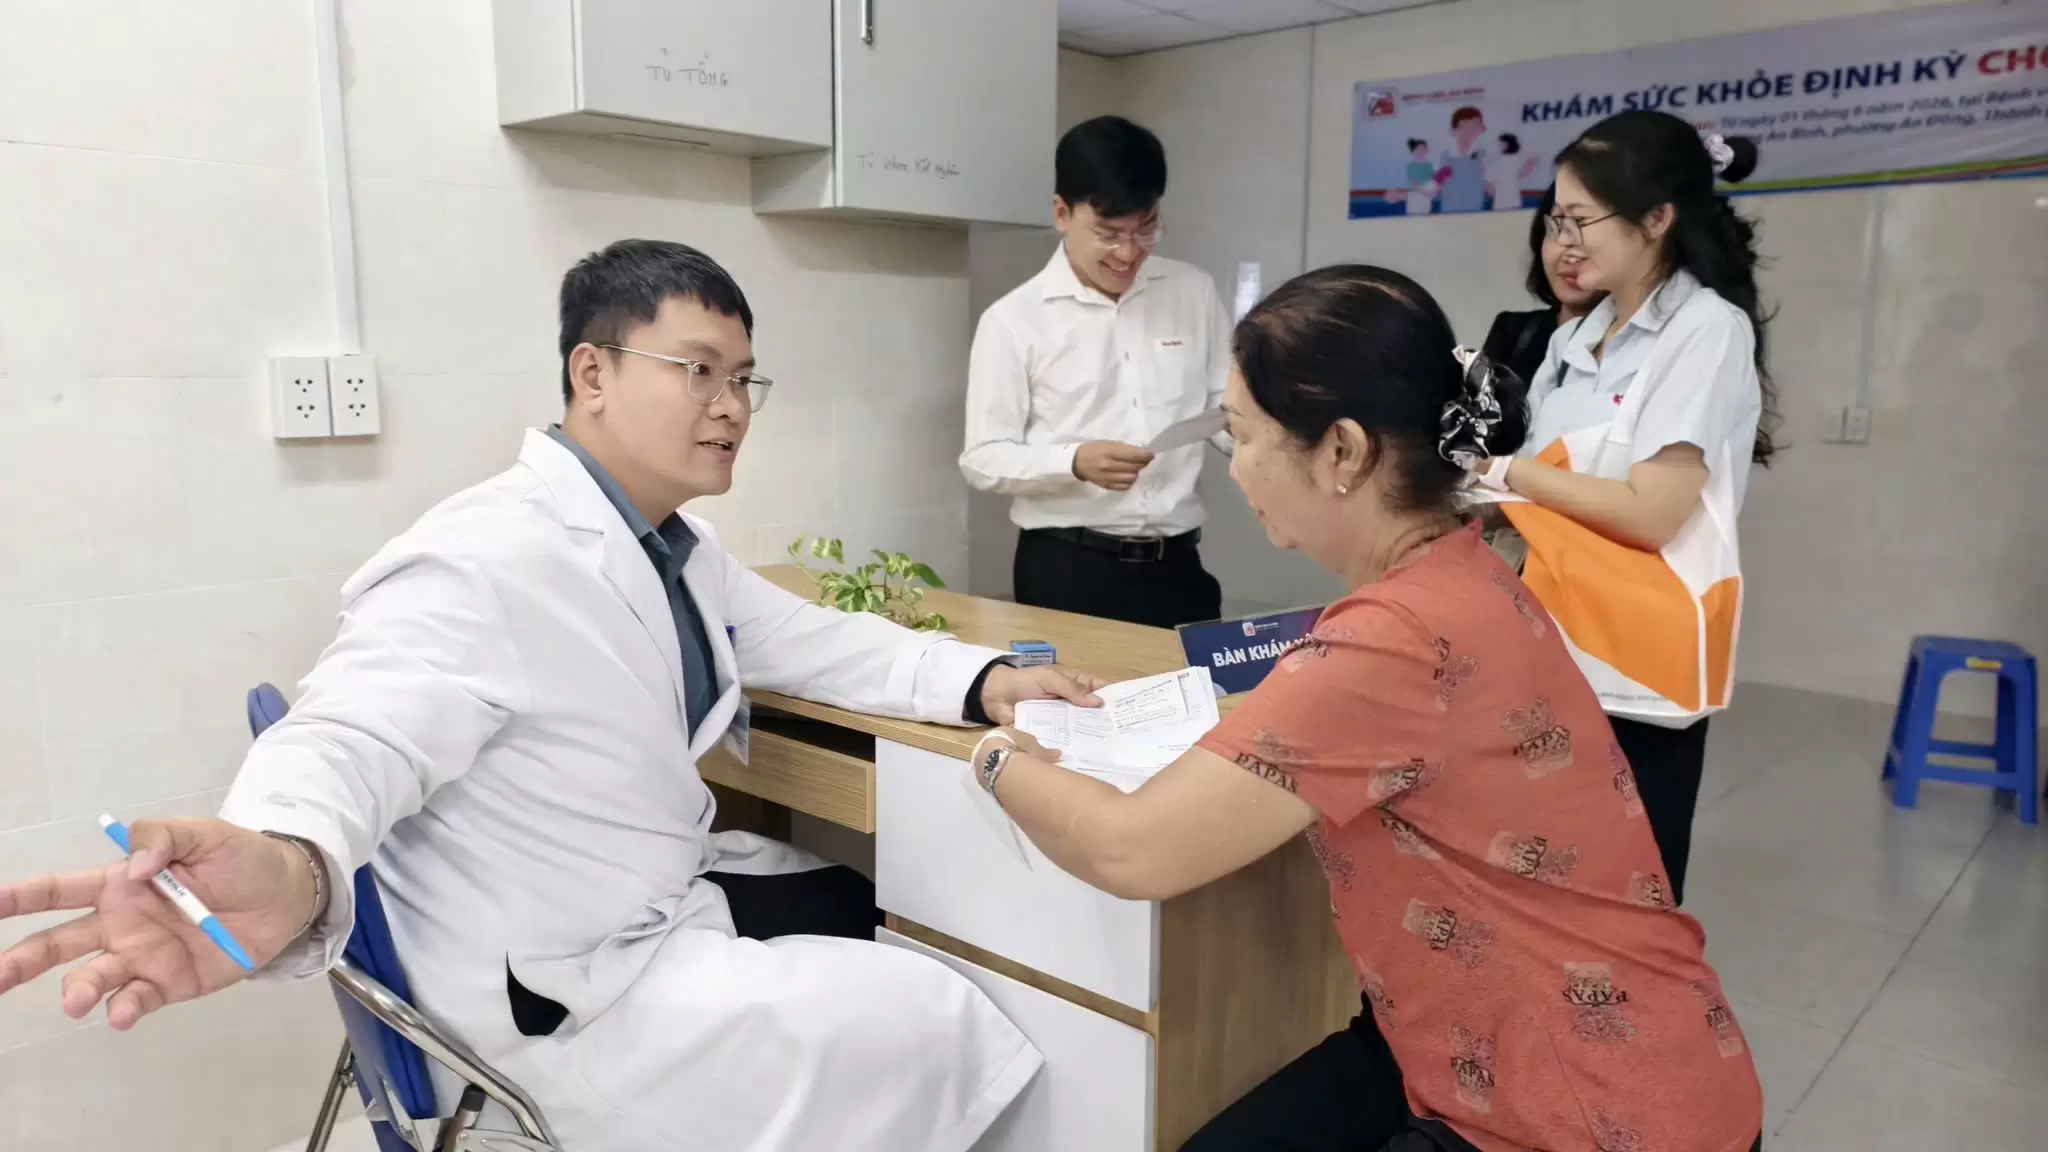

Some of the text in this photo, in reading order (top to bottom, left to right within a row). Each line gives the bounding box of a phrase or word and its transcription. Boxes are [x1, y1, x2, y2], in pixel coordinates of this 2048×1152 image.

[1521, 93, 1613, 124] KHÁM
[1623, 83, 1688, 112] SỨC
[1696, 68, 1794, 105] KHỎE
[1802, 60, 1902, 98] ĐỊNH
[1976, 43, 2048, 76] CH
[1211, 646, 1248, 668] BÀN
[1248, 638, 1291, 662] KHÁM
[1562, 988, 1630, 1005] PAPAS
